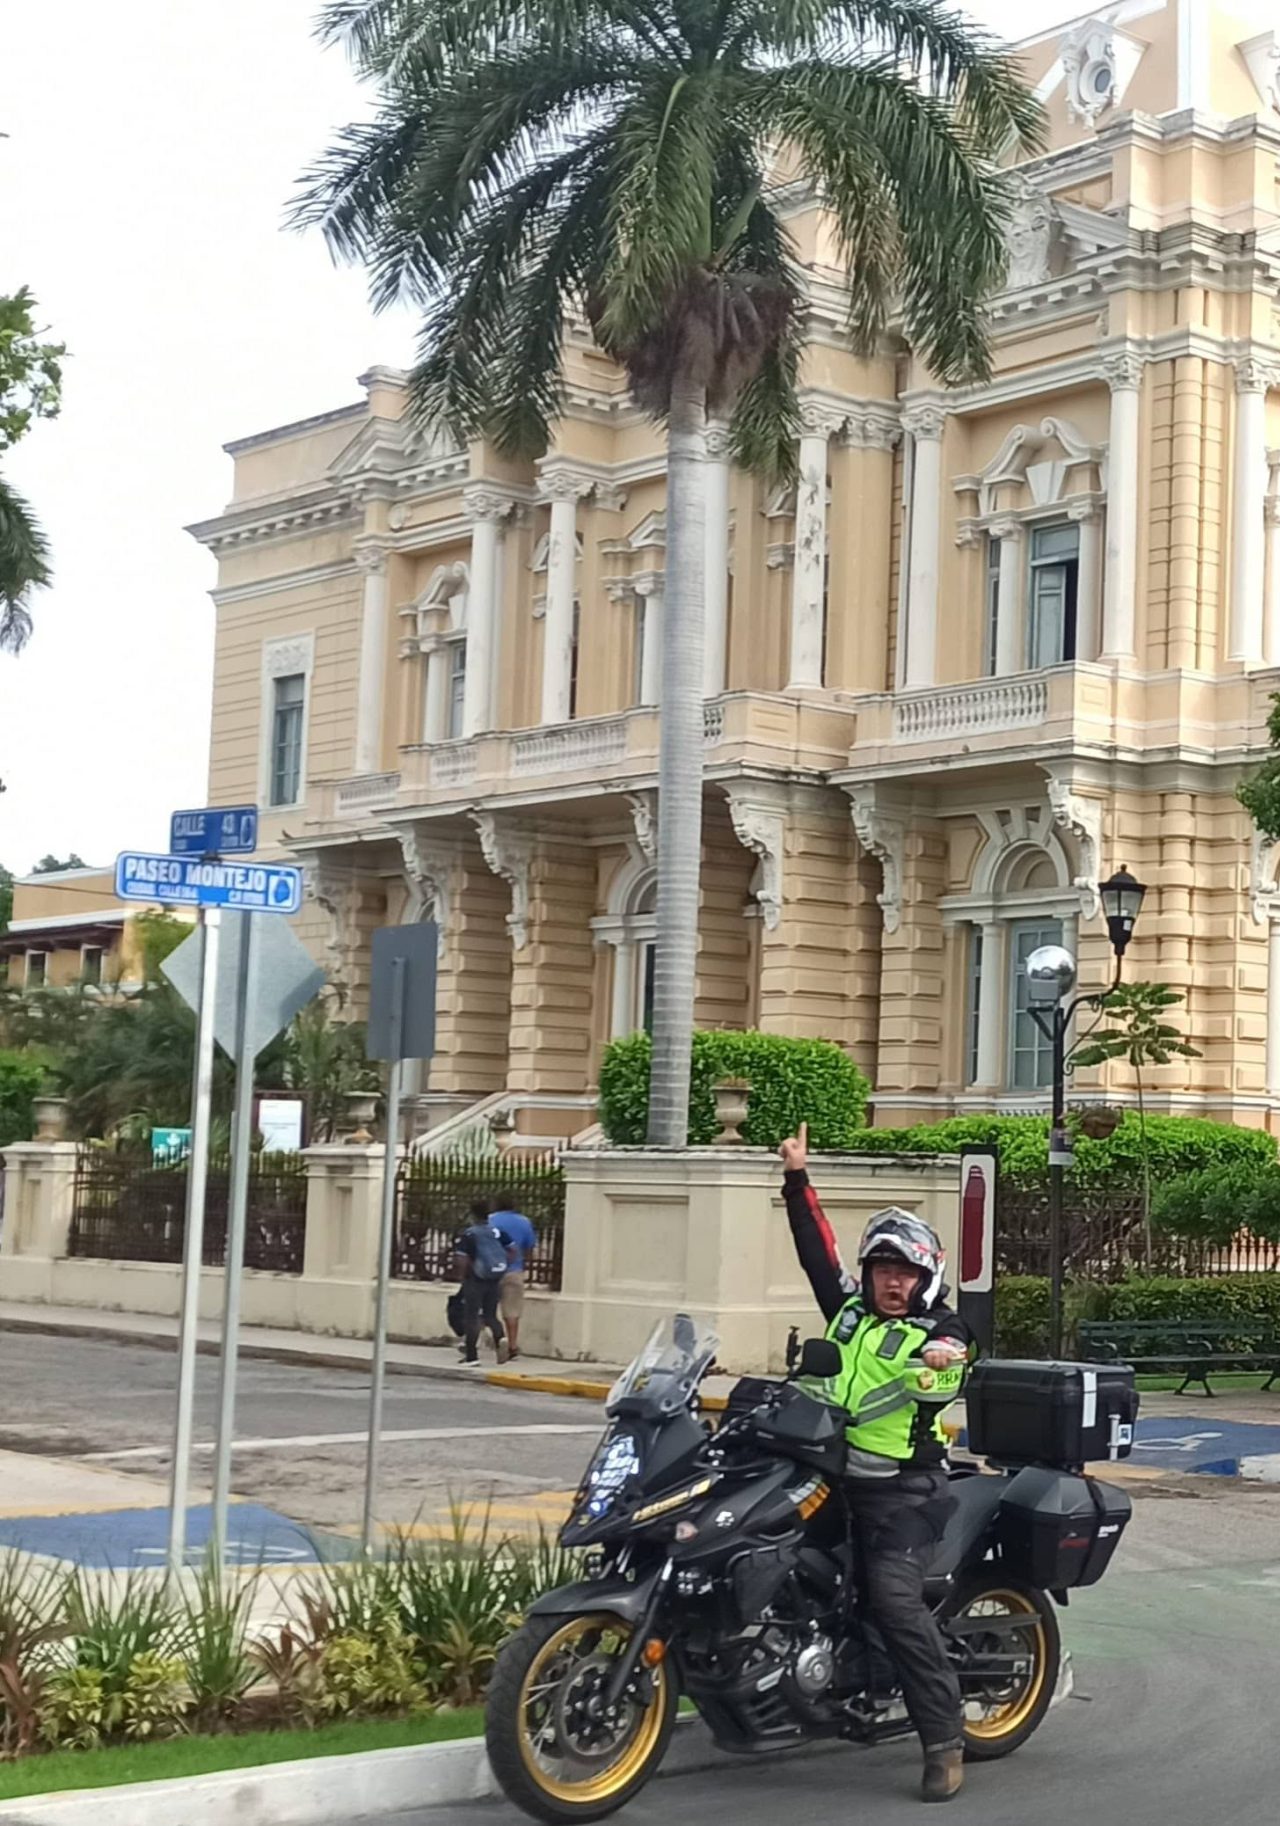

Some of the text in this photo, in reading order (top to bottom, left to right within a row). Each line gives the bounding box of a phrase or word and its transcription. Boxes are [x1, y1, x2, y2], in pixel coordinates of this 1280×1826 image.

[173, 815, 206, 837] CALLE
[125, 858, 181, 884] PASEO
[186, 864, 266, 891] MONTEJO
